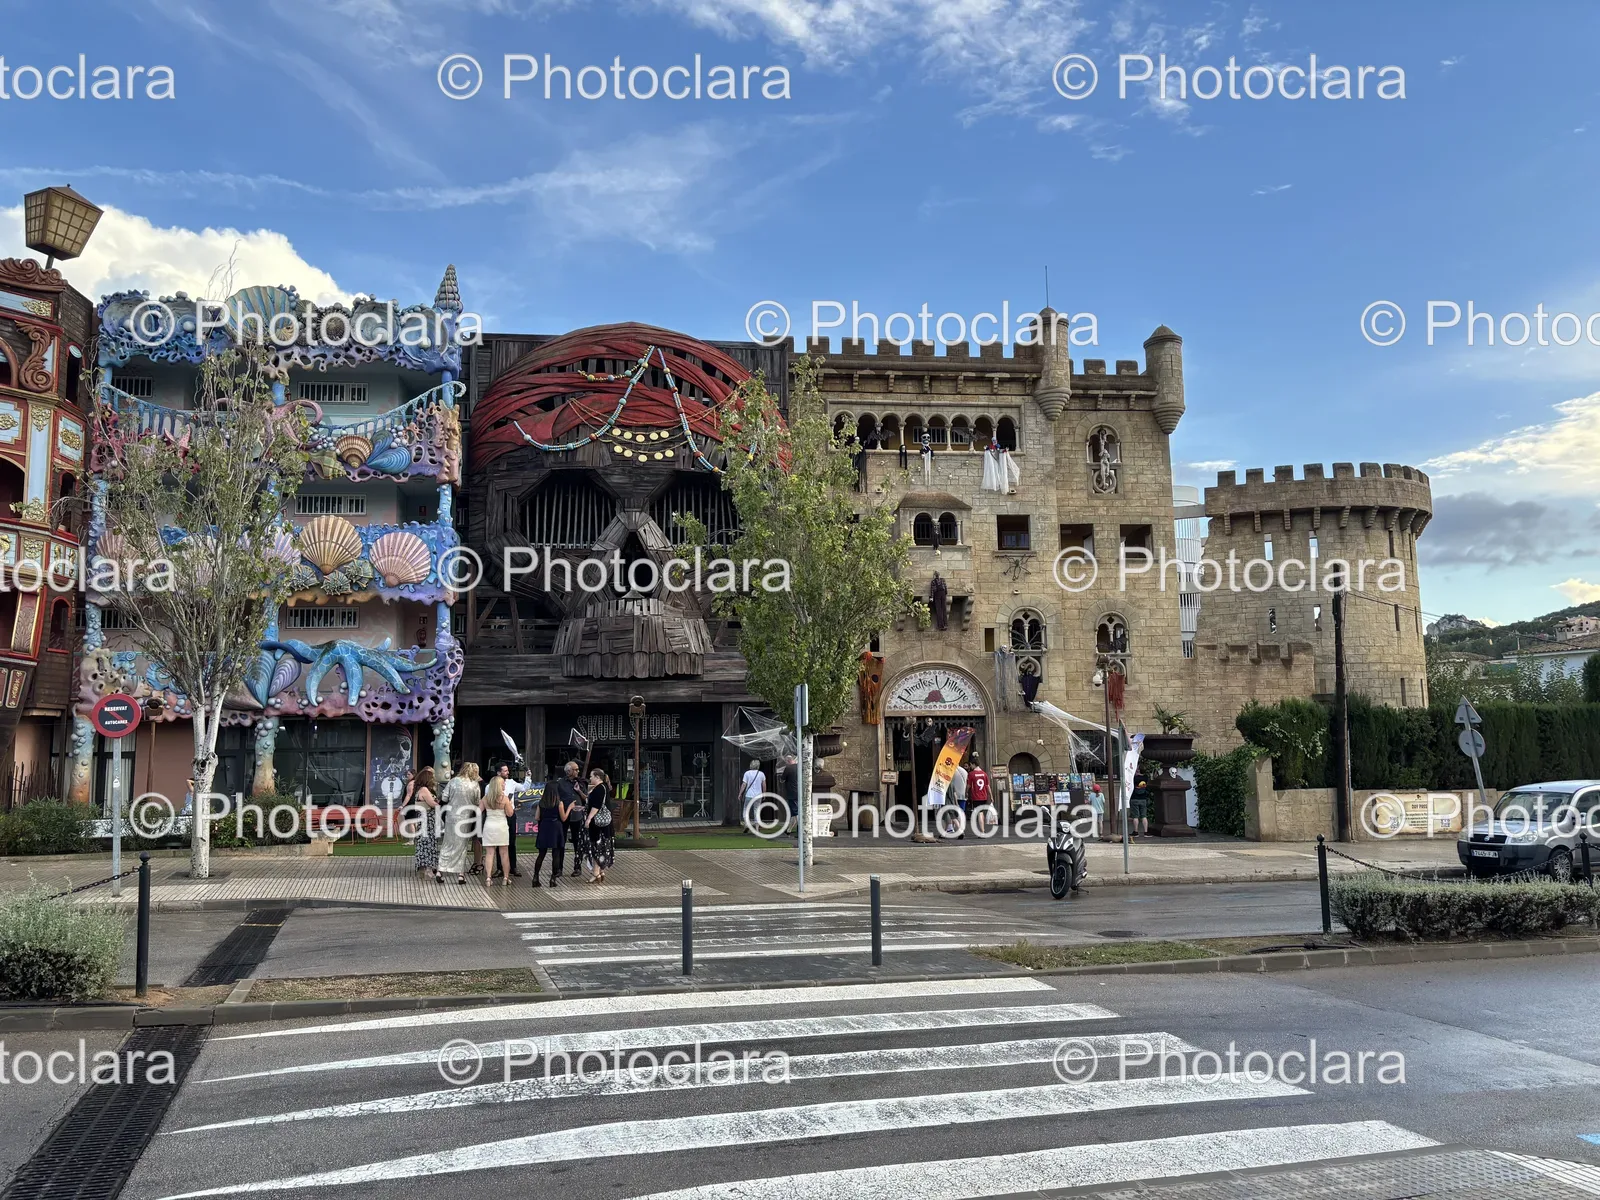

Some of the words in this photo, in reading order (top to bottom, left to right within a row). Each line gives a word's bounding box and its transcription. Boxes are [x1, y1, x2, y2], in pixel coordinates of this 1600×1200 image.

[577, 714, 626, 740] SKULL
[629, 713, 680, 740] STORE
[976, 778, 985, 791] 9
